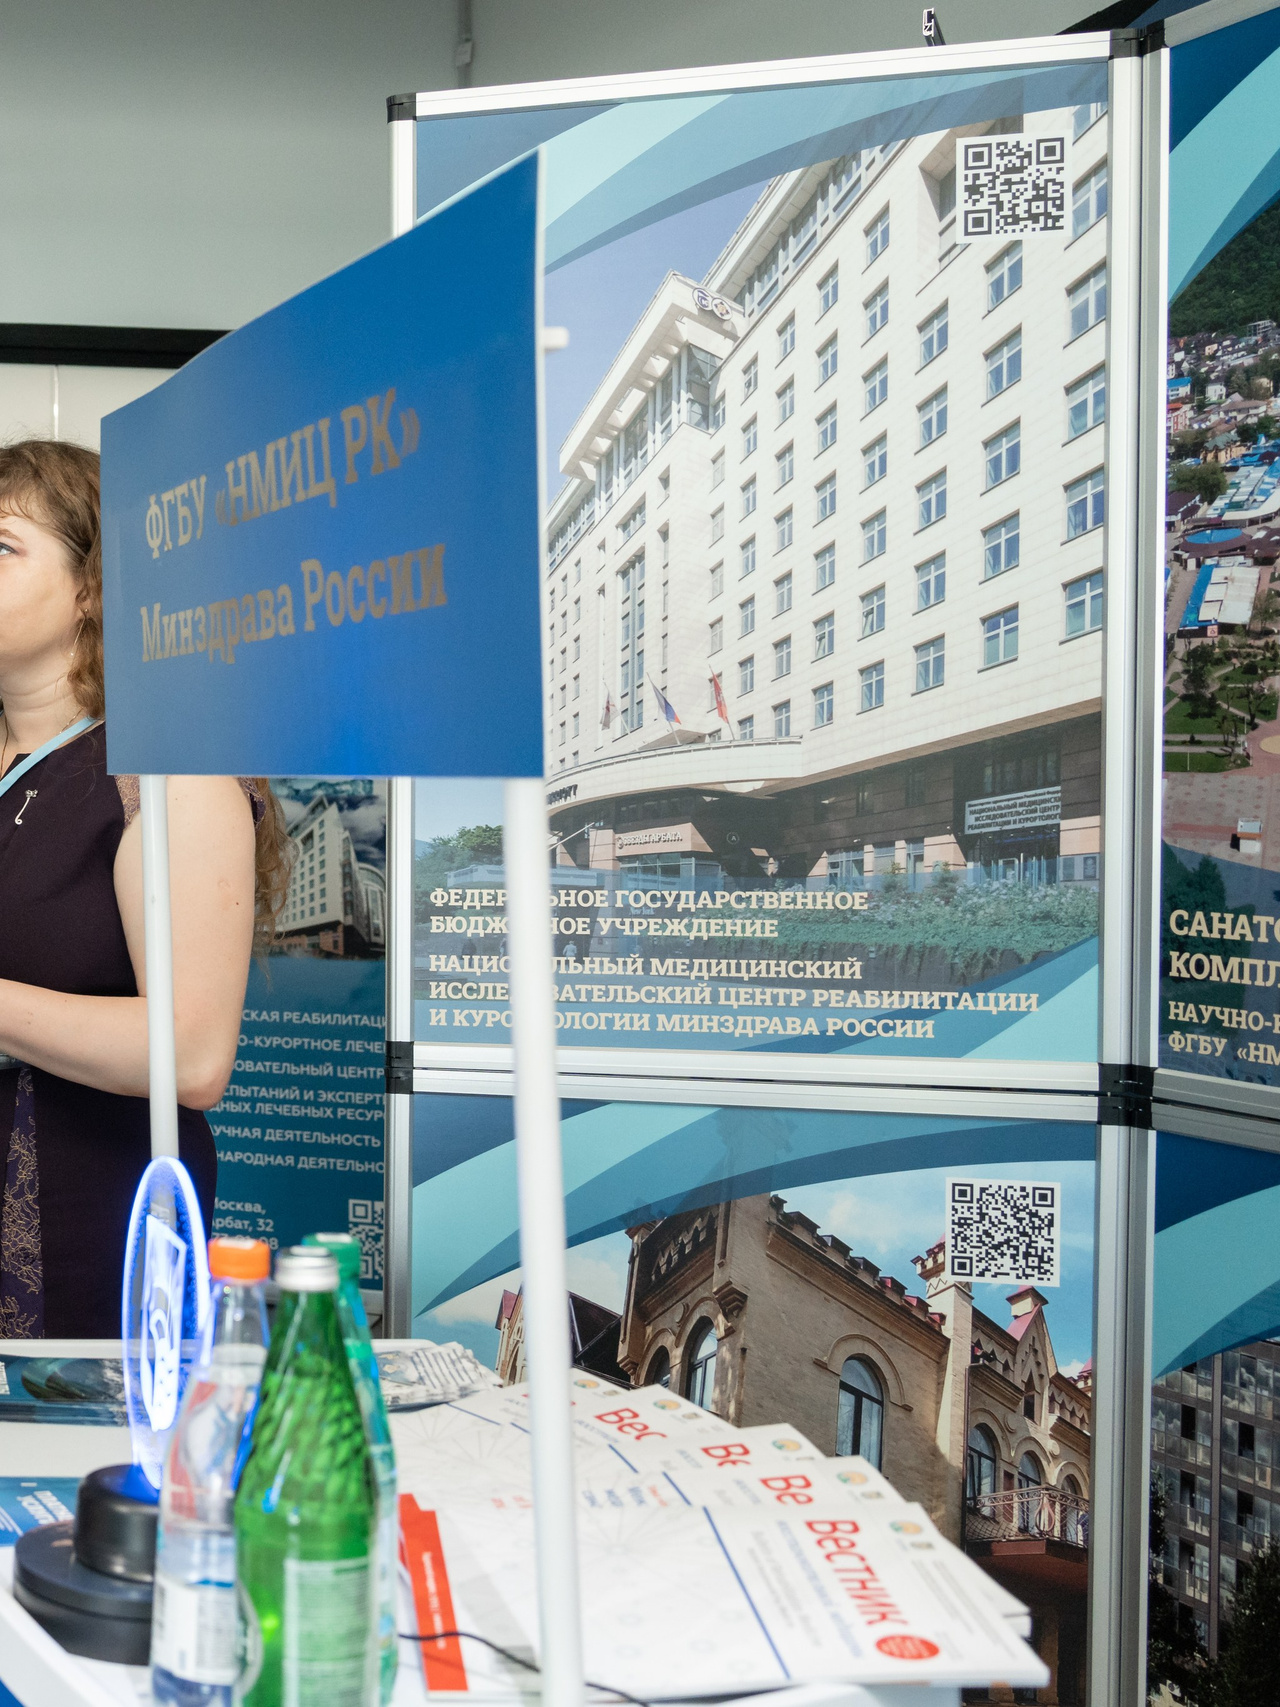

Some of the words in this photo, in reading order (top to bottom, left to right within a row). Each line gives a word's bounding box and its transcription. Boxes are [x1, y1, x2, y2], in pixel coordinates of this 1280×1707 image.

[145, 474, 207, 559] ФГБУ
[214, 417, 337, 528] «НМИЦ
[340, 387, 420, 485] РК»
[140, 583, 296, 665] Минздрава
[300, 543, 448, 633] России
[969, 802, 1017, 815] НАЦИОНАЛЬНЫЙ
[1039, 805, 1060, 813] ЦЕНТР
[429, 888, 608, 910] ФЕДЕРЬНОЕ
[615, 889, 868, 912] ГОСУДАРСТВЕННОЕ
[598, 917, 778, 940] УЧРЕЖДЕНИЕ
[1170, 909, 1280, 944] САНАТ
[429, 953, 643, 977] НАЦИОЛЬНЫЙ
[650, 957, 862, 981] МЕДИЦИНСКИЙ
[718, 986, 806, 1008] ЦЕНТР
[812, 989, 1039, 1014] РЕАБИЛИТАЦИИ
[429, 1009, 447, 1026] И
[453, 1009, 650, 1031] КУРООЛОГИИ
[656, 1013, 820, 1038] МИНЗДРАВА
[826, 1018, 934, 1038] РОССИИ
[344, 1041, 386, 1054] ЛЕЧЕ
[1168, 1030, 1227, 1057] ФГБУ
[337, 1066, 385, 1079] ЦЕНТР
[224, 1084, 300, 1100] ПЫТАНИЙ
[303, 1089, 314, 1101] И
[317, 1090, 386, 1105] ЭКСПЕРТ
[254, 1103, 334, 1119] ЛЕЧЕБНЫХ
[337, 1108, 386, 1122] РЕСУР
[209, 1124, 261, 1140] УЧНАЯ
[264, 1128, 382, 1148] ДЕЯТЕЛЬНОСТЬ
[212, 1216, 252, 1233] рбат,
[256, 1218, 275, 1233] 32
[758, 1474, 814, 1506] Ве
[805, 1519, 909, 1626] Вестник
